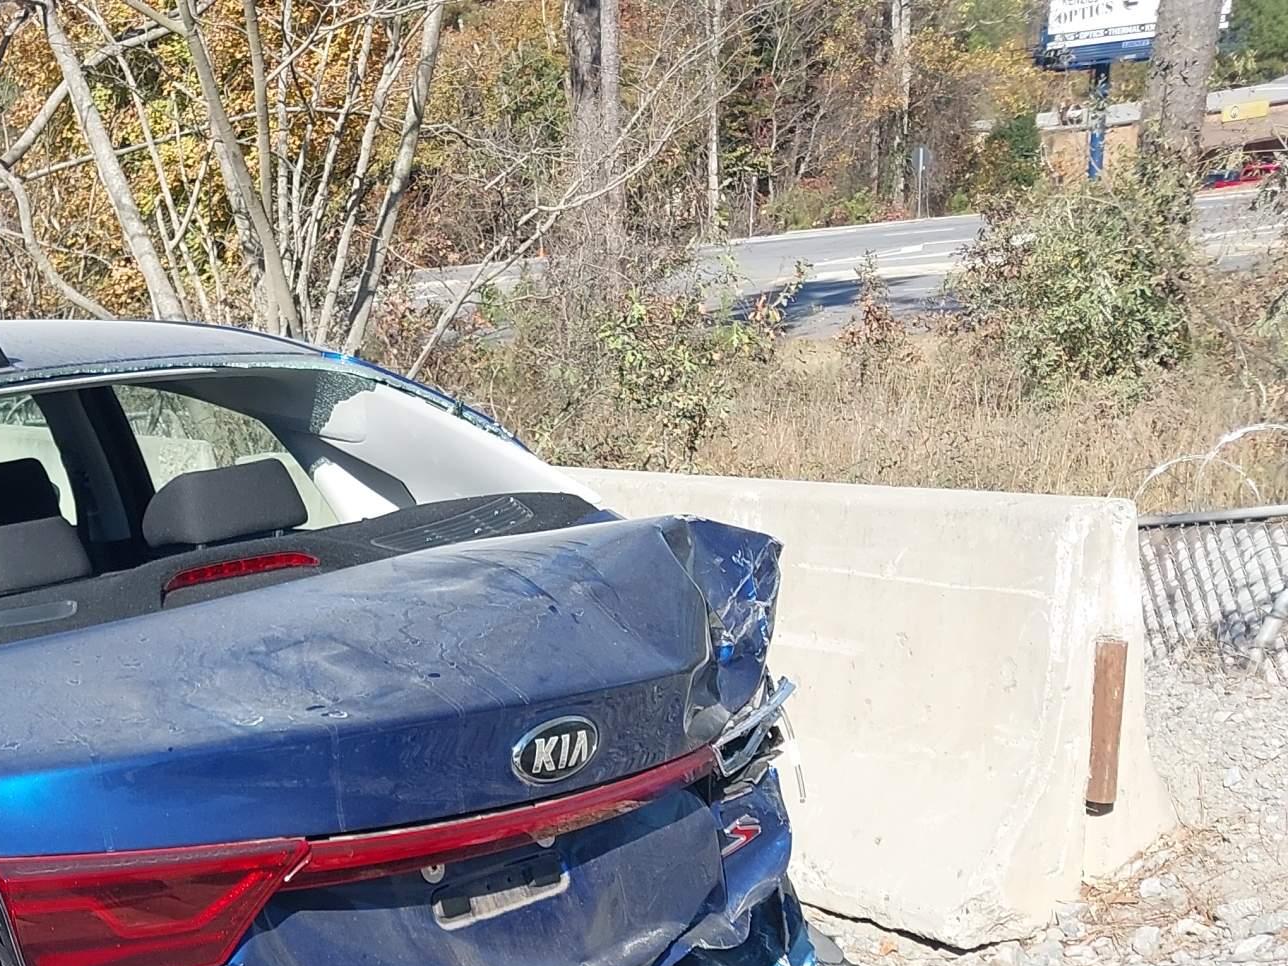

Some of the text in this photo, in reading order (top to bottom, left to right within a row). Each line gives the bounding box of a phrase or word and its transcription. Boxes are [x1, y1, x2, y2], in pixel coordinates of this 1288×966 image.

[1055, 2, 1114, 24] OPTICS
[1108, 24, 1141, 36] THERMAL
[531, 729, 588, 775] KIA
